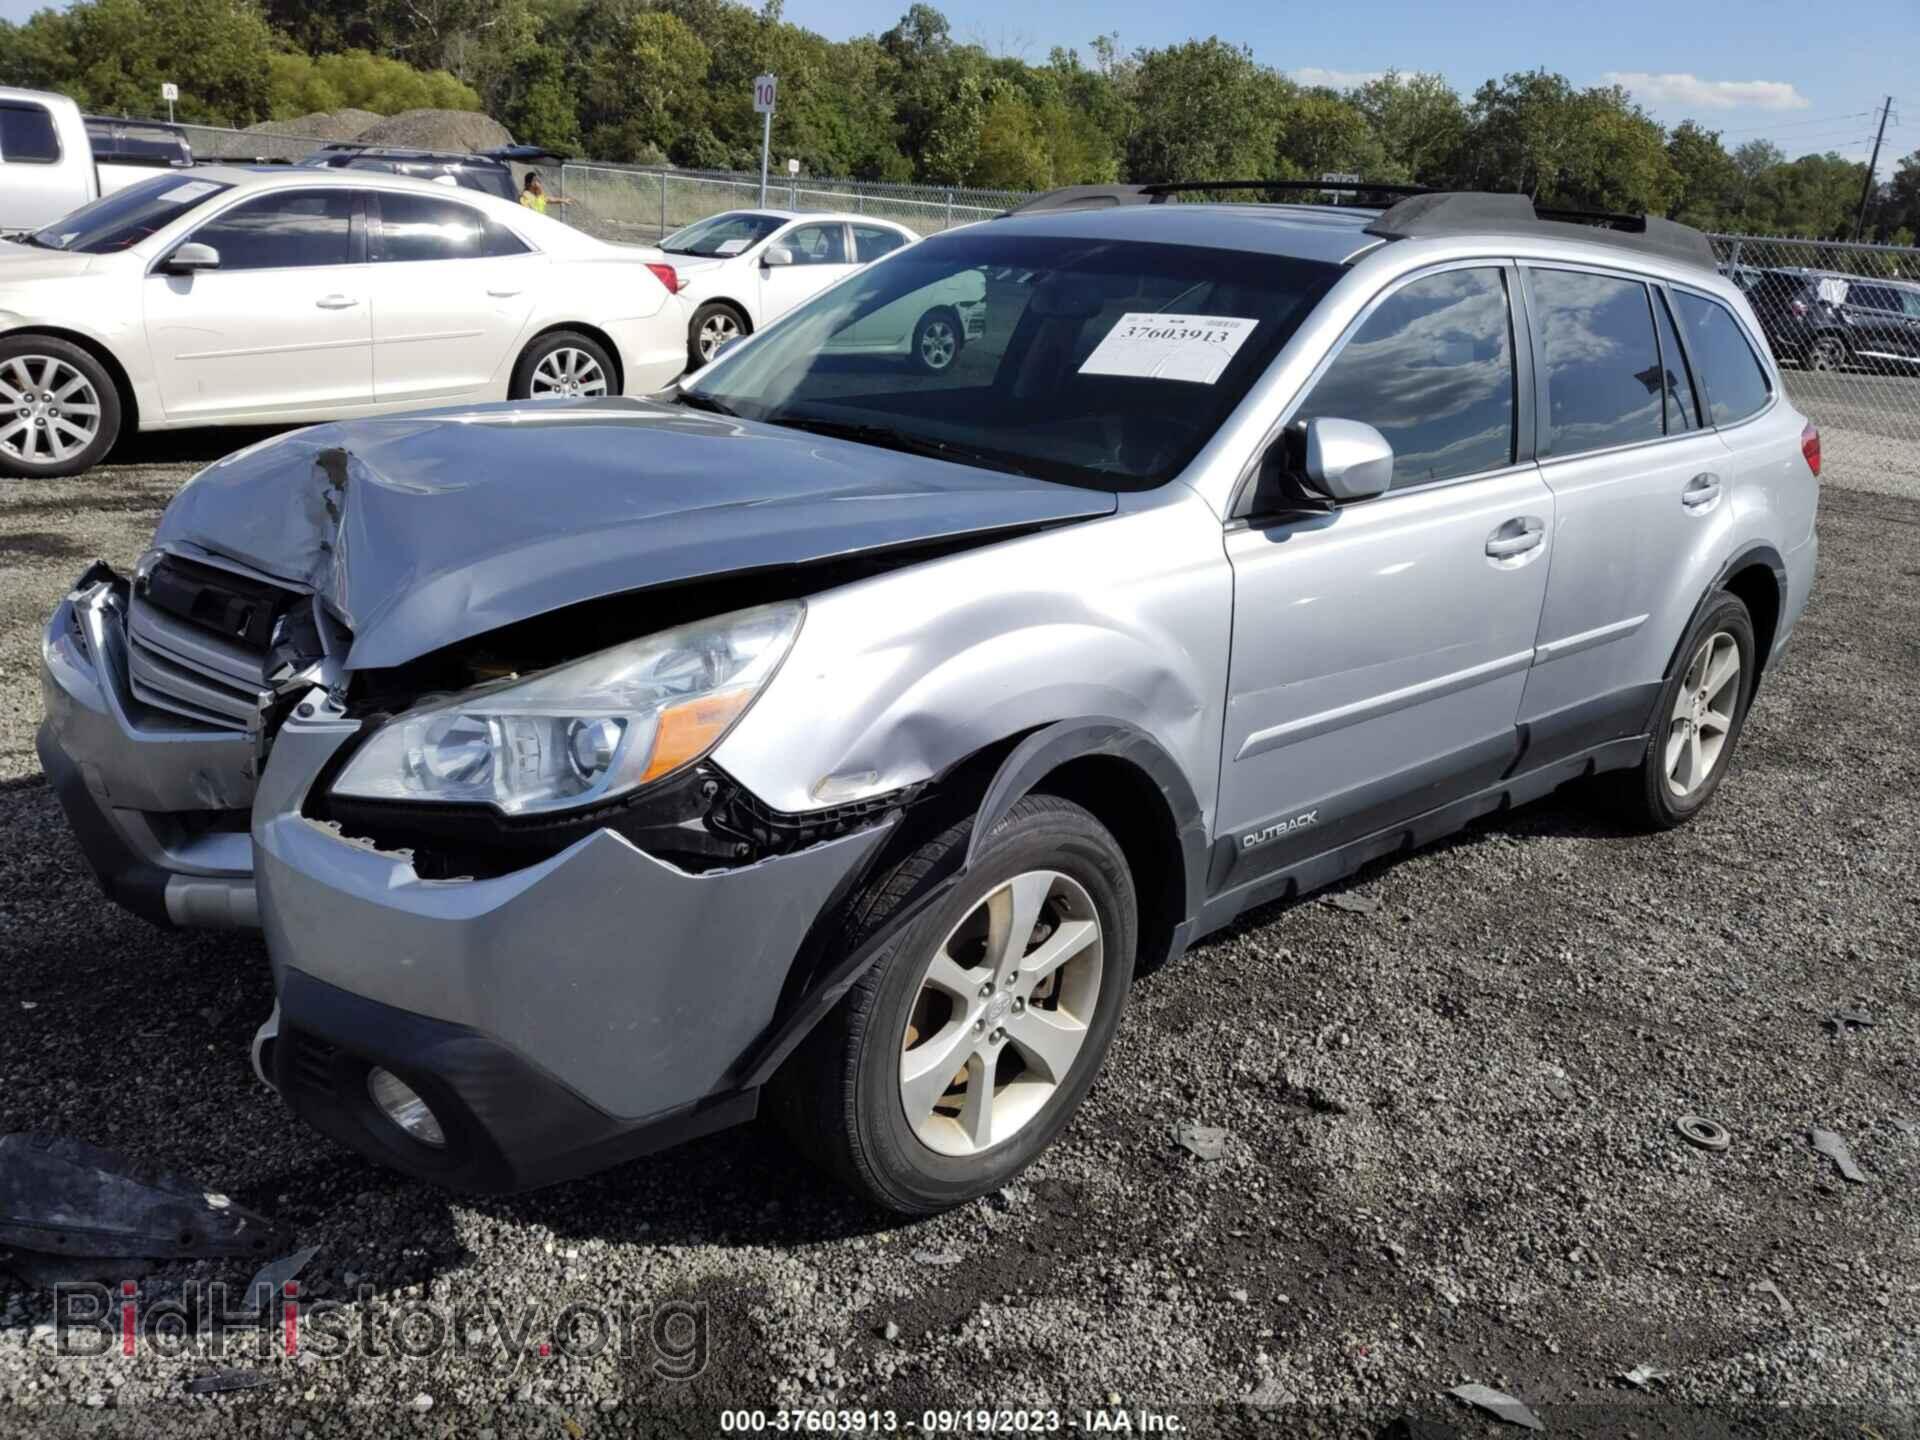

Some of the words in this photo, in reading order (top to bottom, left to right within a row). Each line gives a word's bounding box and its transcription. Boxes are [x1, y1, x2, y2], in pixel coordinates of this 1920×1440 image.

[757, 84, 774, 105] 10
[1120, 326, 1230, 344] 37603913
[1242, 809, 1319, 848] OUTBACK
